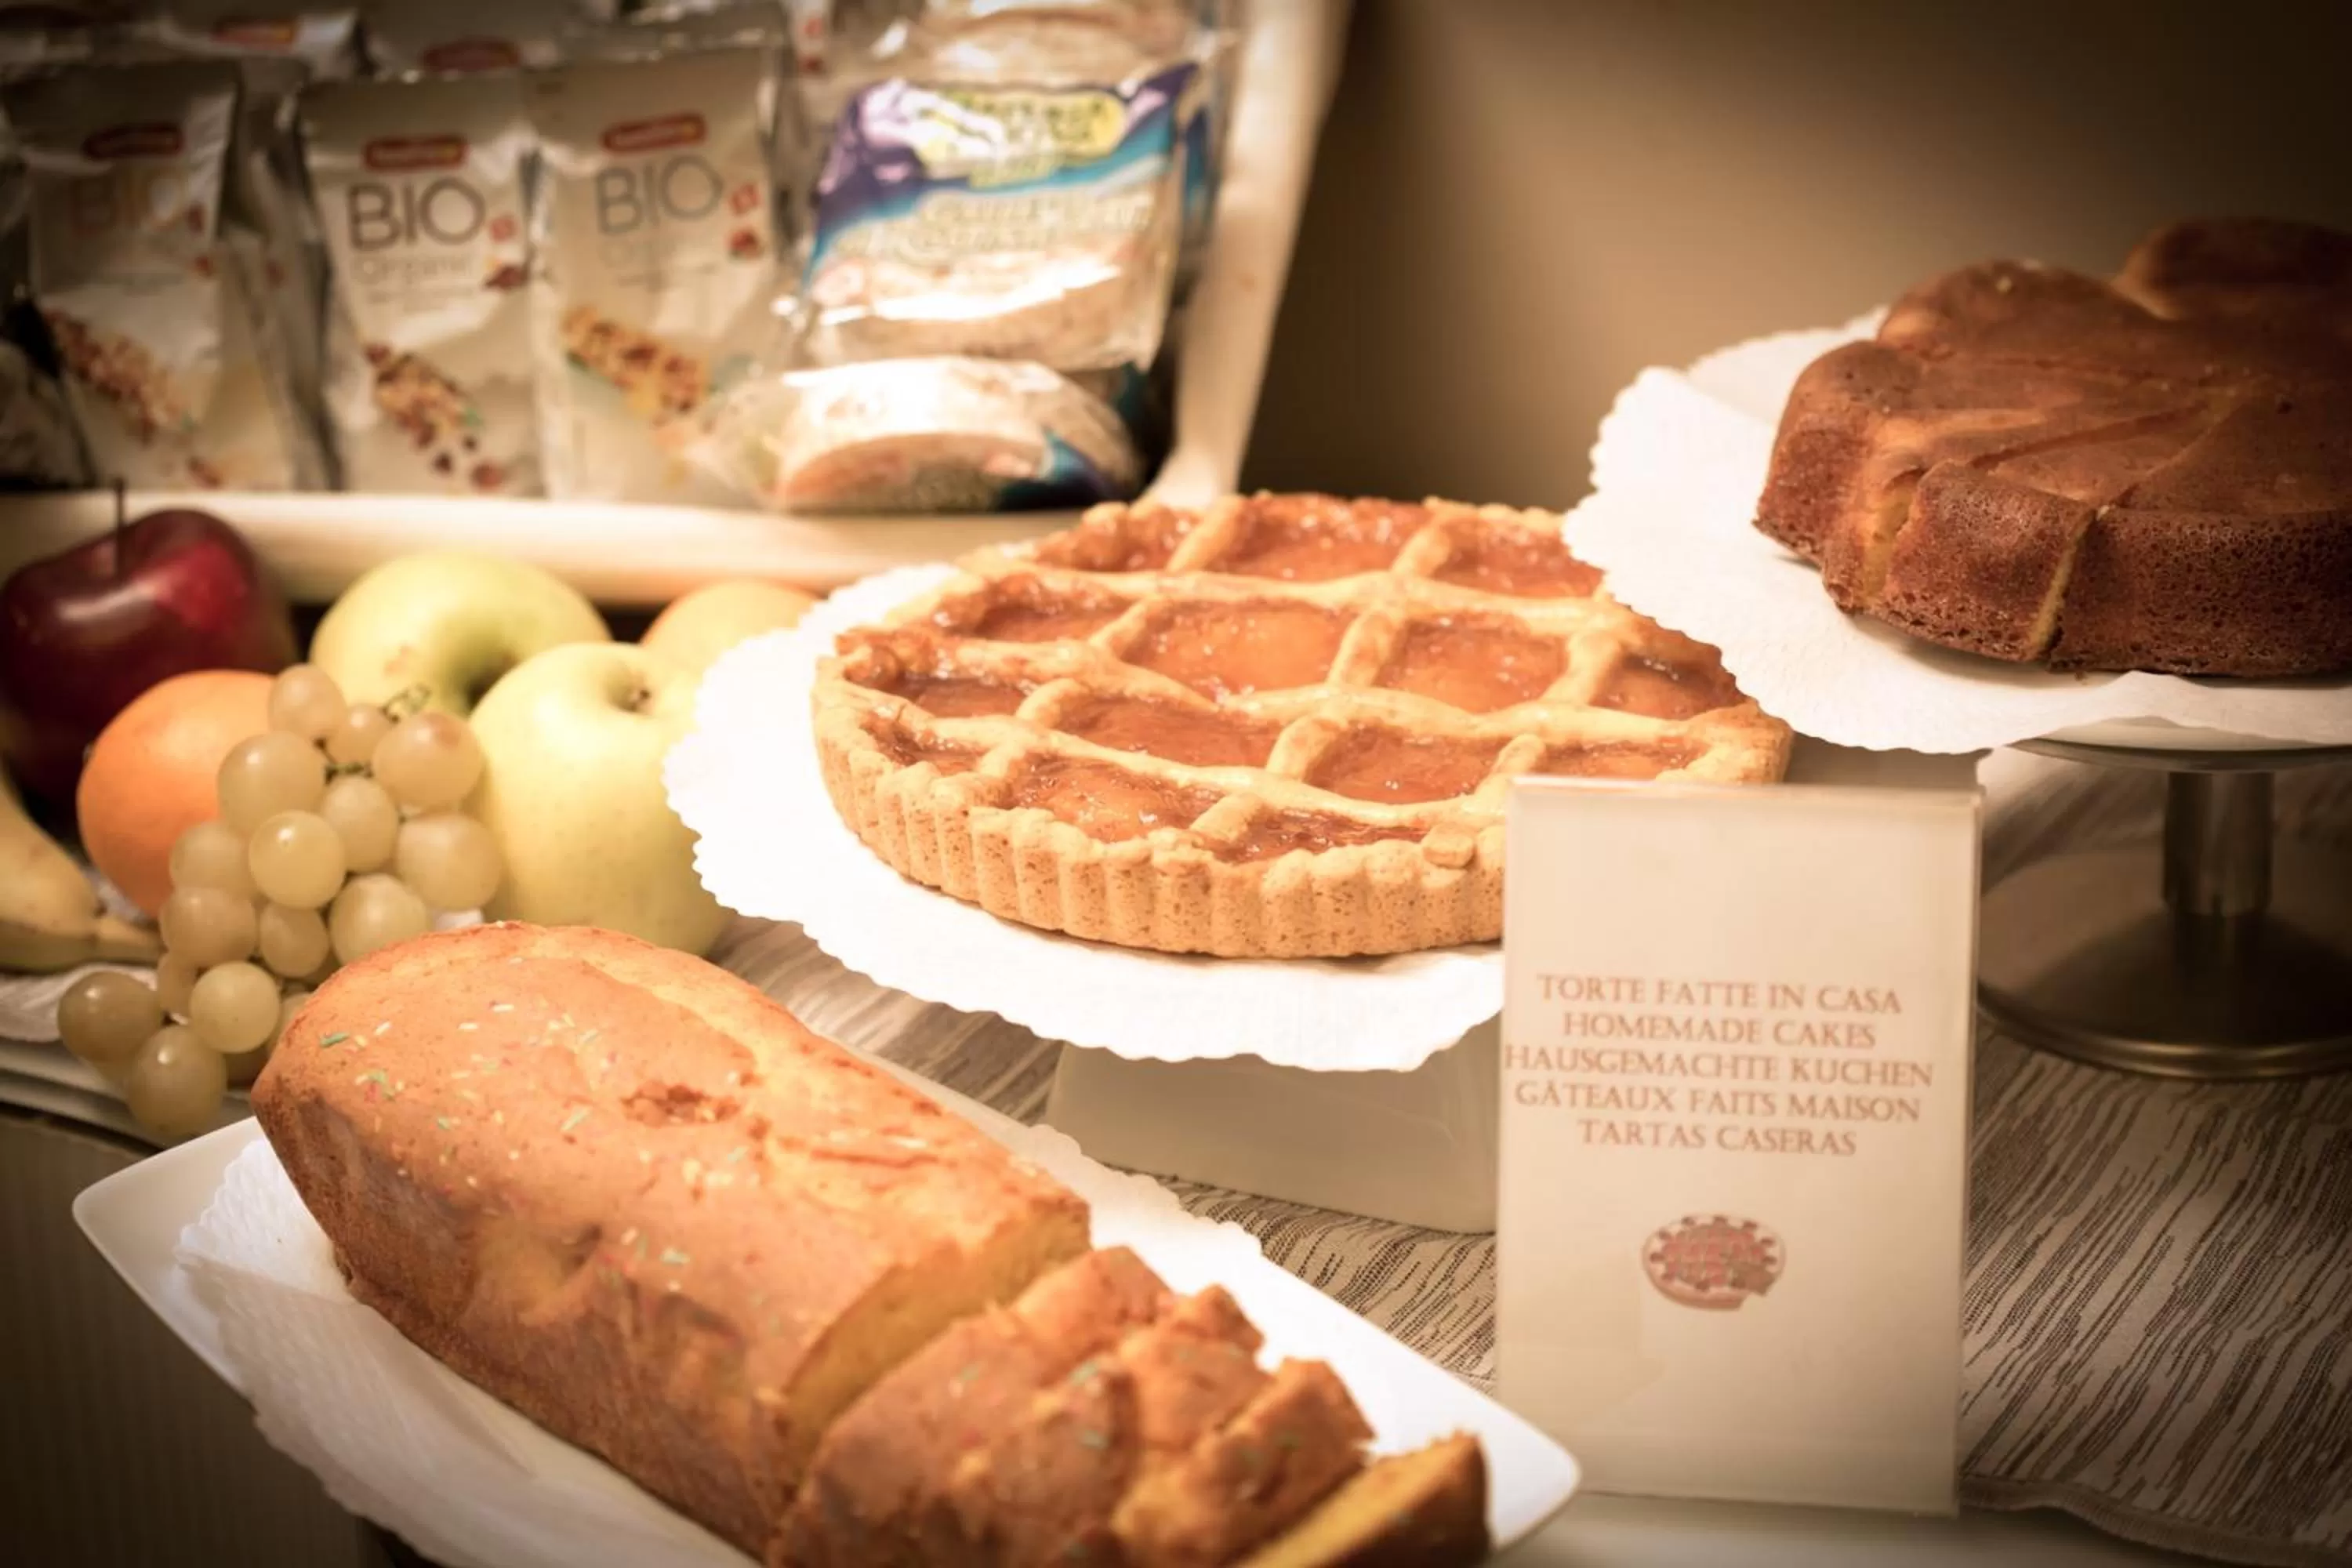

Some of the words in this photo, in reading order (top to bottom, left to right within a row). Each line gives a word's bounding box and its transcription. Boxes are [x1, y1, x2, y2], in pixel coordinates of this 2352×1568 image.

[349, 176, 487, 252] BIO
[594, 155, 725, 236] BIO
[1537, 973, 1644, 1004] TORTE
[1656, 980, 1756, 1008] FATTE
[1769, 983, 1806, 1011] IN
[1816, 985, 1903, 1015] CASA
[1563, 1011, 1762, 1045] HOMEMADE
[1773, 1019, 1876, 1049] CAKES
[1504, 1045, 1779, 1081] HAUSGEMACHTE
[1789, 1057, 1935, 1088] KUCHEN
[1689, 1088, 1776, 1117] FAITS
[1787, 1094, 1920, 1123] MAISON
[1577, 1118, 1706, 1149] TARTAS
[1715, 1124, 1857, 1156] CASERAS
